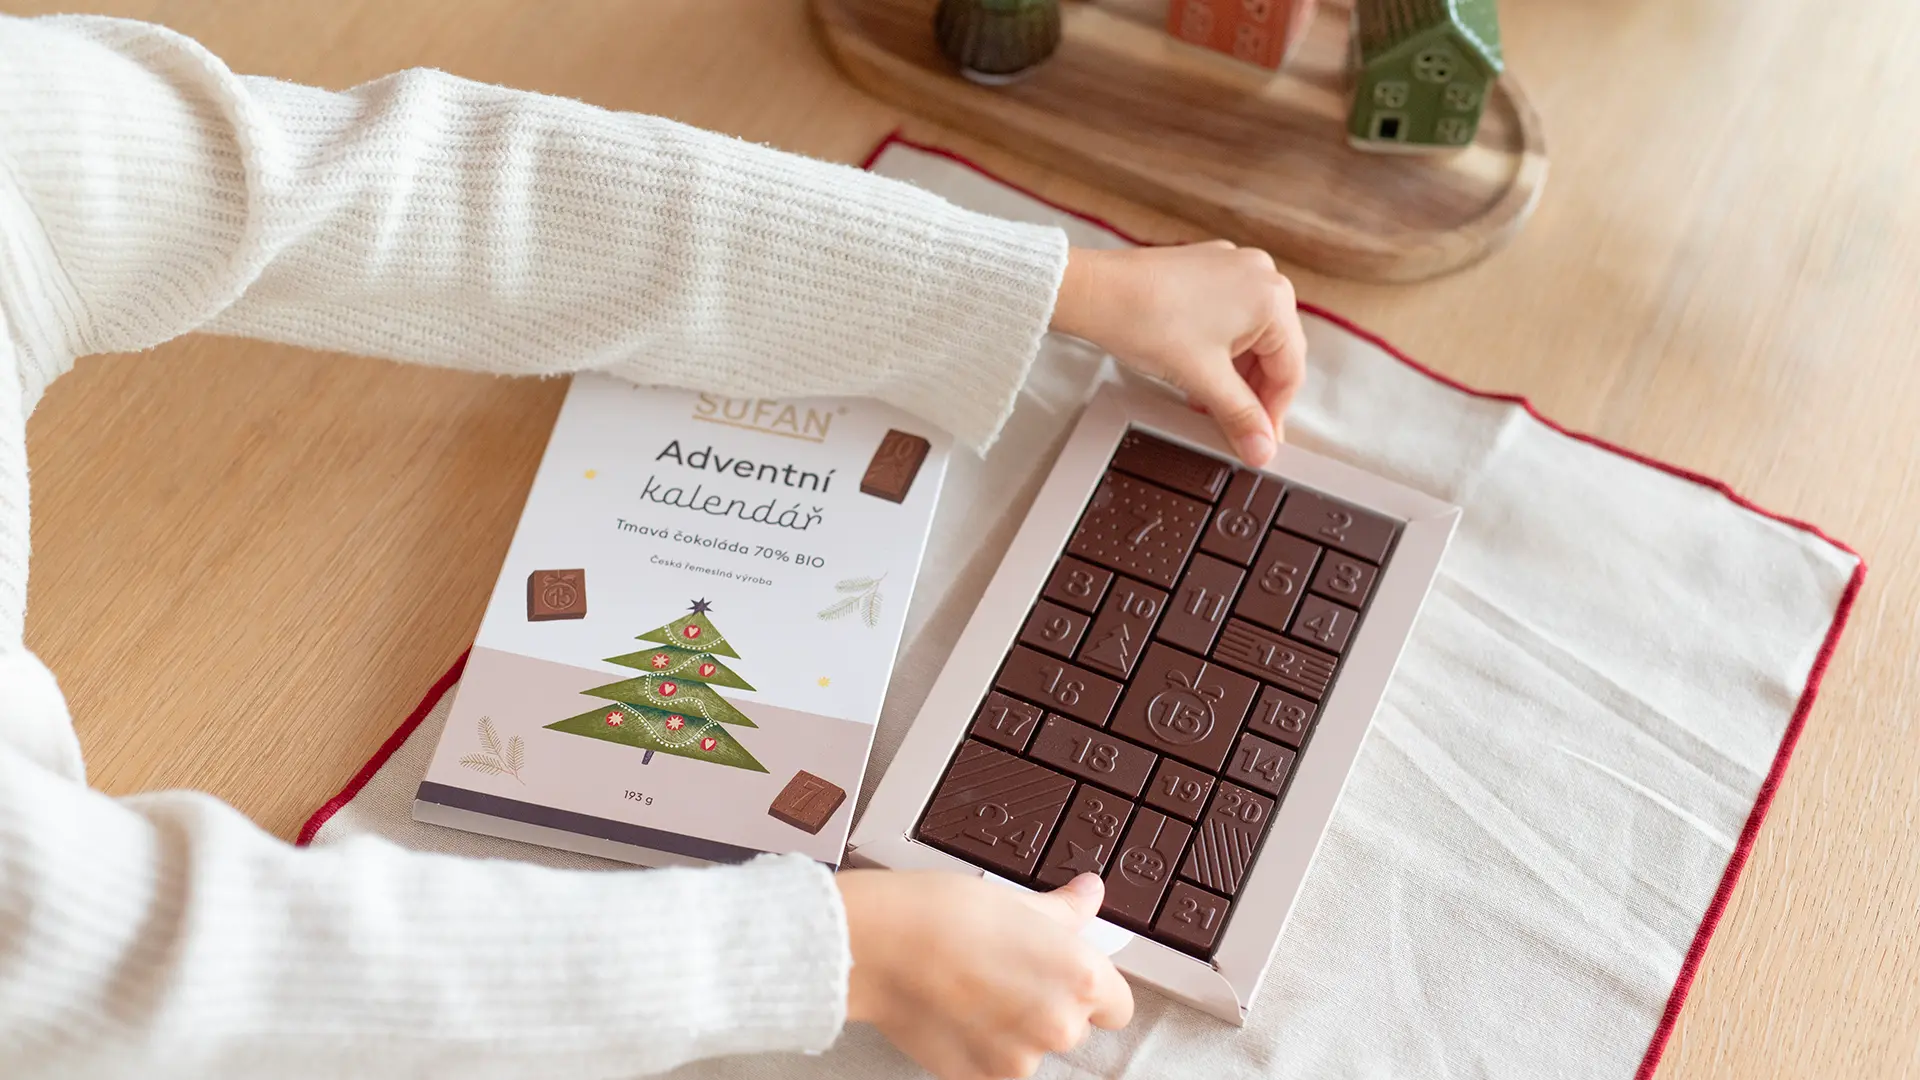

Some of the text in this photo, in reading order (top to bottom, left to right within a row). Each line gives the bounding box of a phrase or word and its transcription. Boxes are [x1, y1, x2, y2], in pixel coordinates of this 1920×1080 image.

[655, 438, 837, 494] Adventní
[640, 475, 823, 531] kalendář
[1124, 506, 1164, 545] 7
[1318, 511, 1353, 542] 2
[616, 518, 825, 569] Tmavá čokoláda 70% BIO
[650, 554, 773, 587] Česká řemeslná výroba
[1259, 561, 1298, 596] 5
[547, 586, 572, 607] 15
[1115, 591, 1156, 619] 10
[1186, 585, 1225, 622] 11
[1040, 617, 1072, 641] 9
[1302, 610, 1340, 642] 4
[1255, 644, 1296, 675] 12
[1039, 666, 1085, 707] 16
[988, 706, 1032, 738] 17
[1158, 700, 1205, 735] 15
[1262, 699, 1307, 733] 13
[1070, 736, 1120, 774] 18
[1243, 747, 1284, 783] 14
[623, 789, 654, 806] 193 g
[792, 780, 825, 810] 7
[1159, 775, 1201, 803] 19
[1077, 799, 1120, 838] 23
[1225, 793, 1263, 825] 20
[961, 803, 1044, 859] 24
[1124, 850, 1164, 881] 22
[1172, 898, 1216, 930] 21
